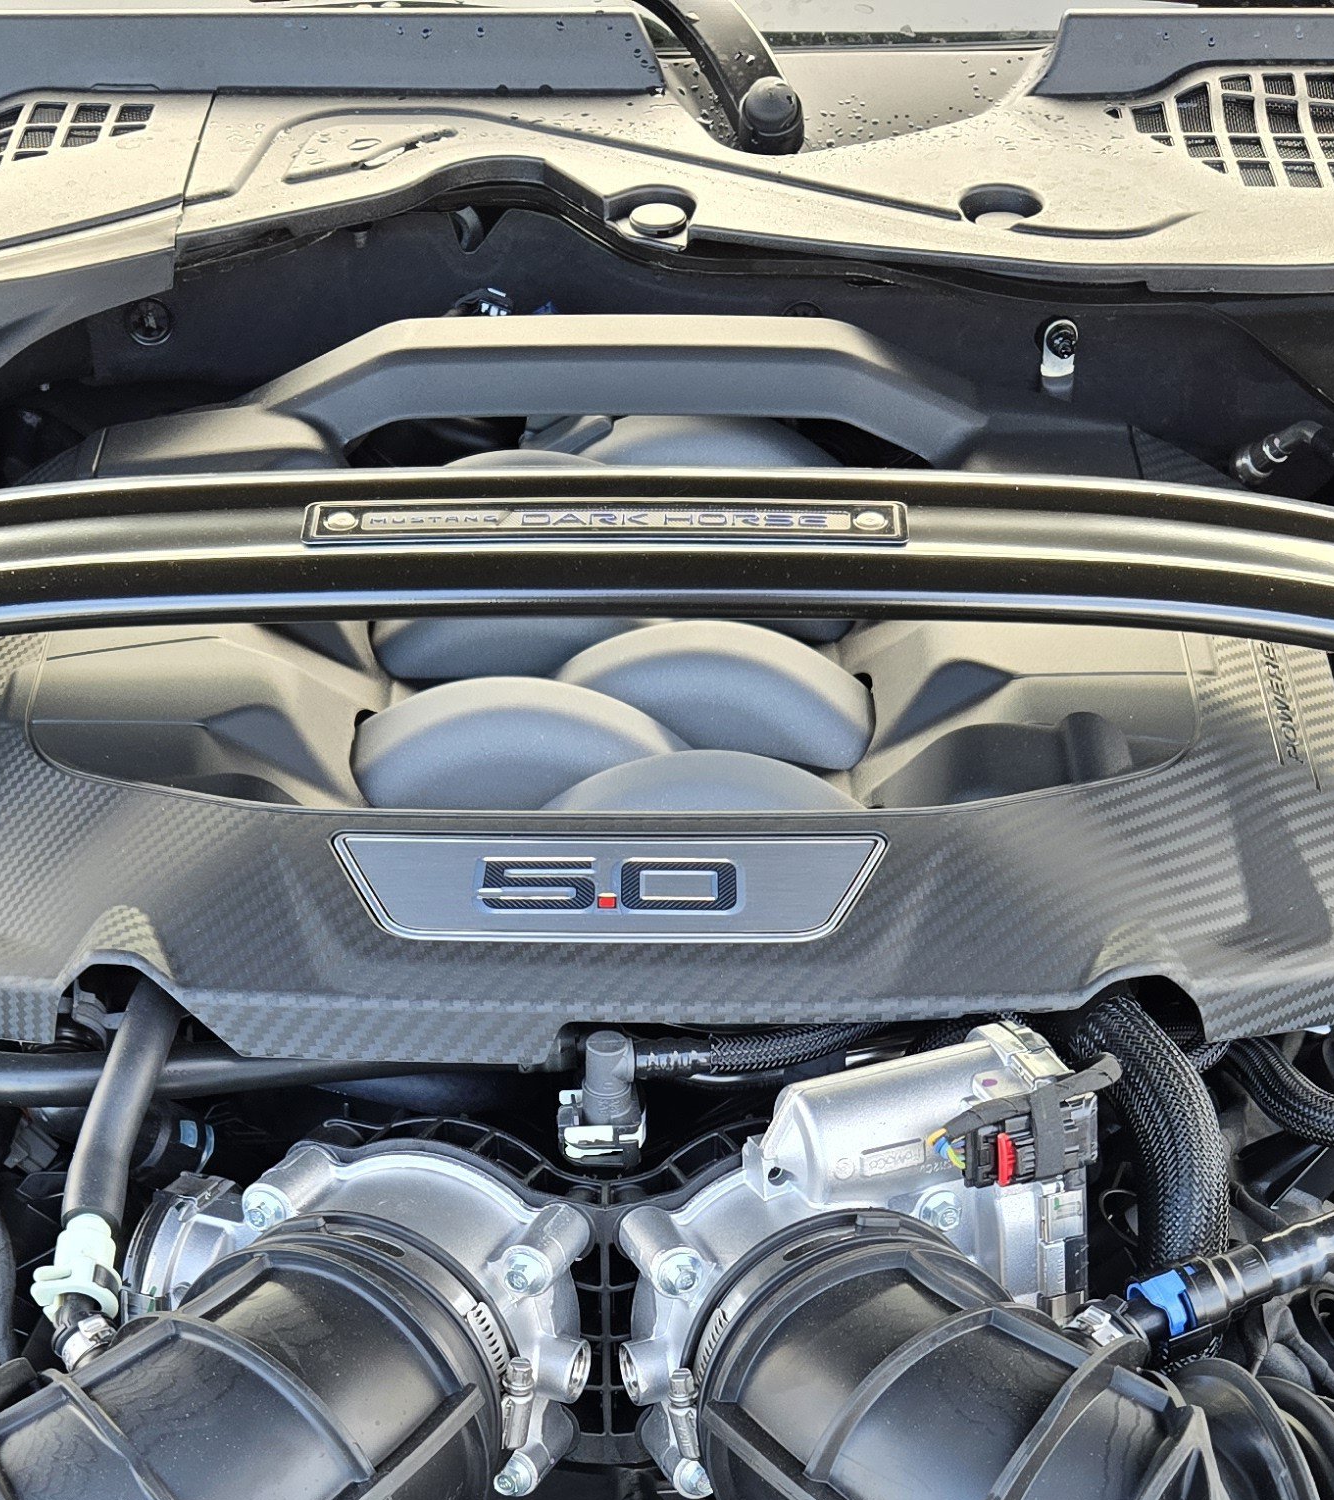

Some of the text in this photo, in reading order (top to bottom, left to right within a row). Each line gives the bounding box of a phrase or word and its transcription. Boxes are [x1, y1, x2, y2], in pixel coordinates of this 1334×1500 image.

[369, 512, 829, 528] MUSTANG DARK HORSE
[1259, 640, 1304, 765] POWERE
[473, 856, 744, 915] 5.0
